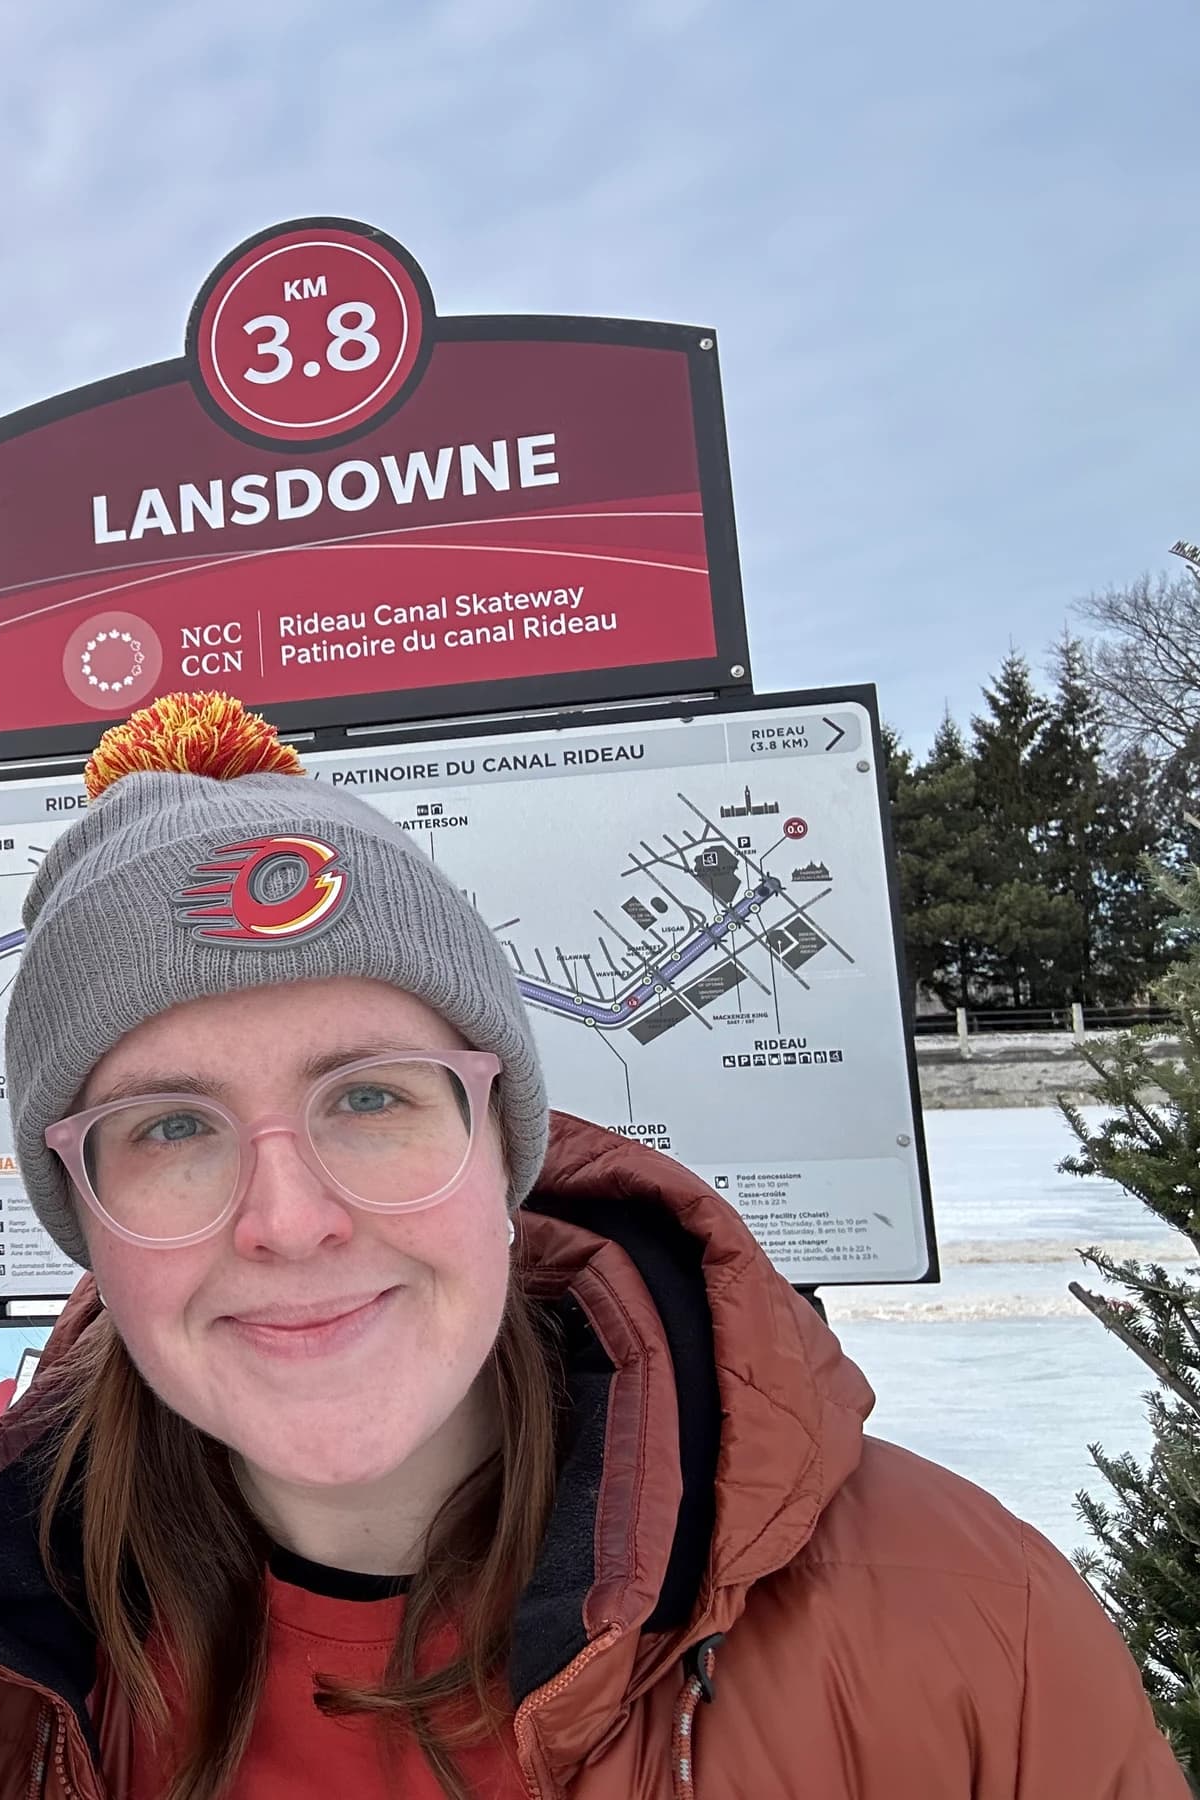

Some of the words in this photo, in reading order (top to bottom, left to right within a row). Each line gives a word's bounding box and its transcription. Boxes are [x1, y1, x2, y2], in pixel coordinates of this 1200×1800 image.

[284, 275, 328, 302] KM
[242, 301, 380, 384] 3.8
[93, 433, 560, 544] LANSDOWNE
[279, 612, 366, 638] Rideau
[374, 597, 447, 626] Canal
[456, 586, 584, 617] Skateway
[181, 622, 242, 649] NCC
[280, 635, 396, 667] Patinoire
[402, 629, 436, 653] du
[444, 619, 515, 648] canal
[523, 612, 617, 640] Rideau
[181, 650, 243, 677] CCN
[751, 725, 805, 739] RIDEAU
[750, 741, 777, 752] (3.8
[782, 738, 809, 749] KM)
[332, 763, 439, 786] PATINOIRE
[446, 760, 476, 776] DU
[482, 753, 557, 773] CANAL
[563, 744, 645, 766] RIDEAU
[45, 794, 88, 811] RIDE
[787, 824, 805, 834] 0.0
[754, 1037, 807, 1051] RIDEAU
[607, 1123, 667, 1136] ONCORD
[757, 1172, 802, 1180] concessions
[770, 1211, 797, 1220] Facility
